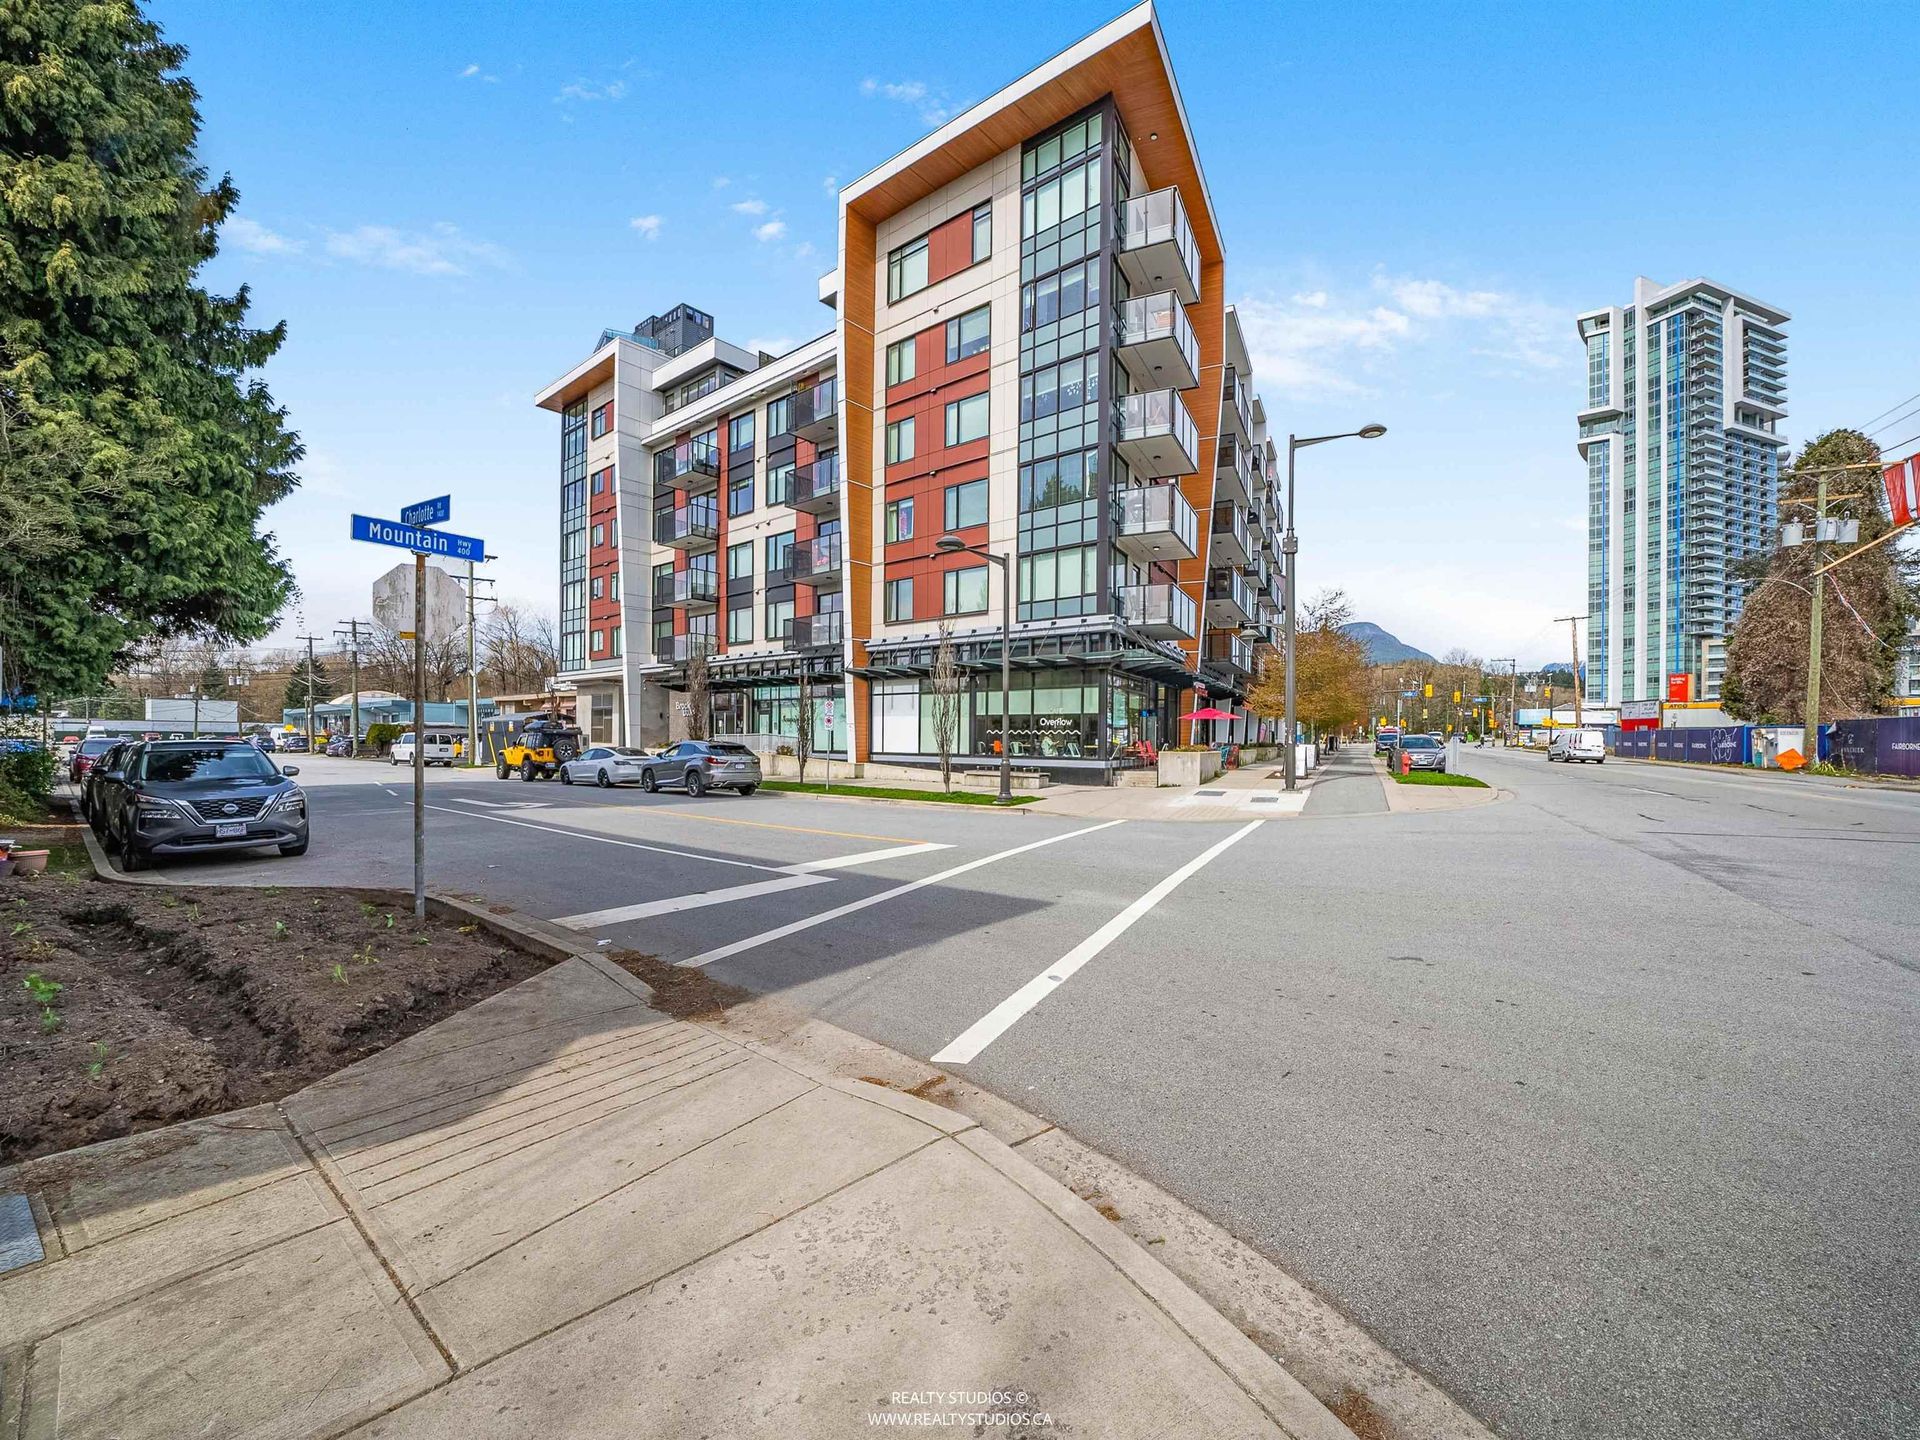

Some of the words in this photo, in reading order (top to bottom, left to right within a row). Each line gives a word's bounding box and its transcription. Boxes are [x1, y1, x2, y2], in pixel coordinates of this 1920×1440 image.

[405, 505, 434, 524] Charlotte
[369, 522, 448, 552] Mountain
[457, 547, 471, 556] 400
[1040, 717, 1073, 729] Overflow
